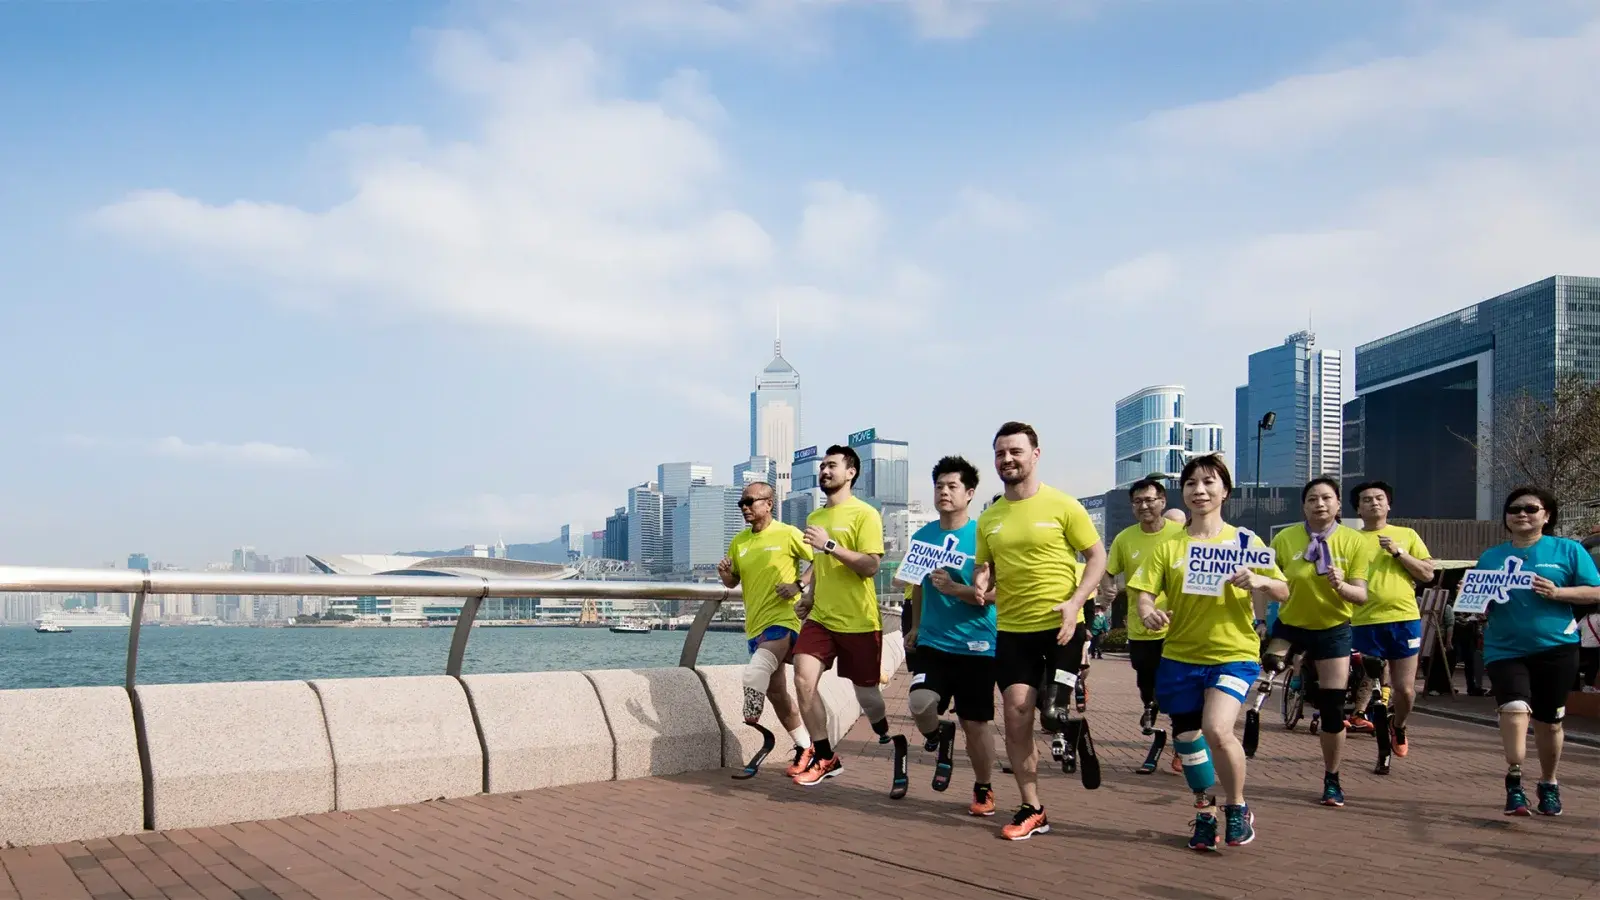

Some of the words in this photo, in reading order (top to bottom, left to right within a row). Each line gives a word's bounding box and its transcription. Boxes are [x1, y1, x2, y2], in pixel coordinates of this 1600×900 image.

[852, 429, 871, 443] MOVE
[1089, 499, 1103, 507] edge
[911, 541, 964, 566] RUNNING
[1190, 545, 1271, 565] RUNNING
[901, 563, 926, 576] 2017
[1187, 572, 1223, 586] 2017
[1466, 572, 1531, 587] RUNNING
[1459, 594, 1488, 604] 2017
